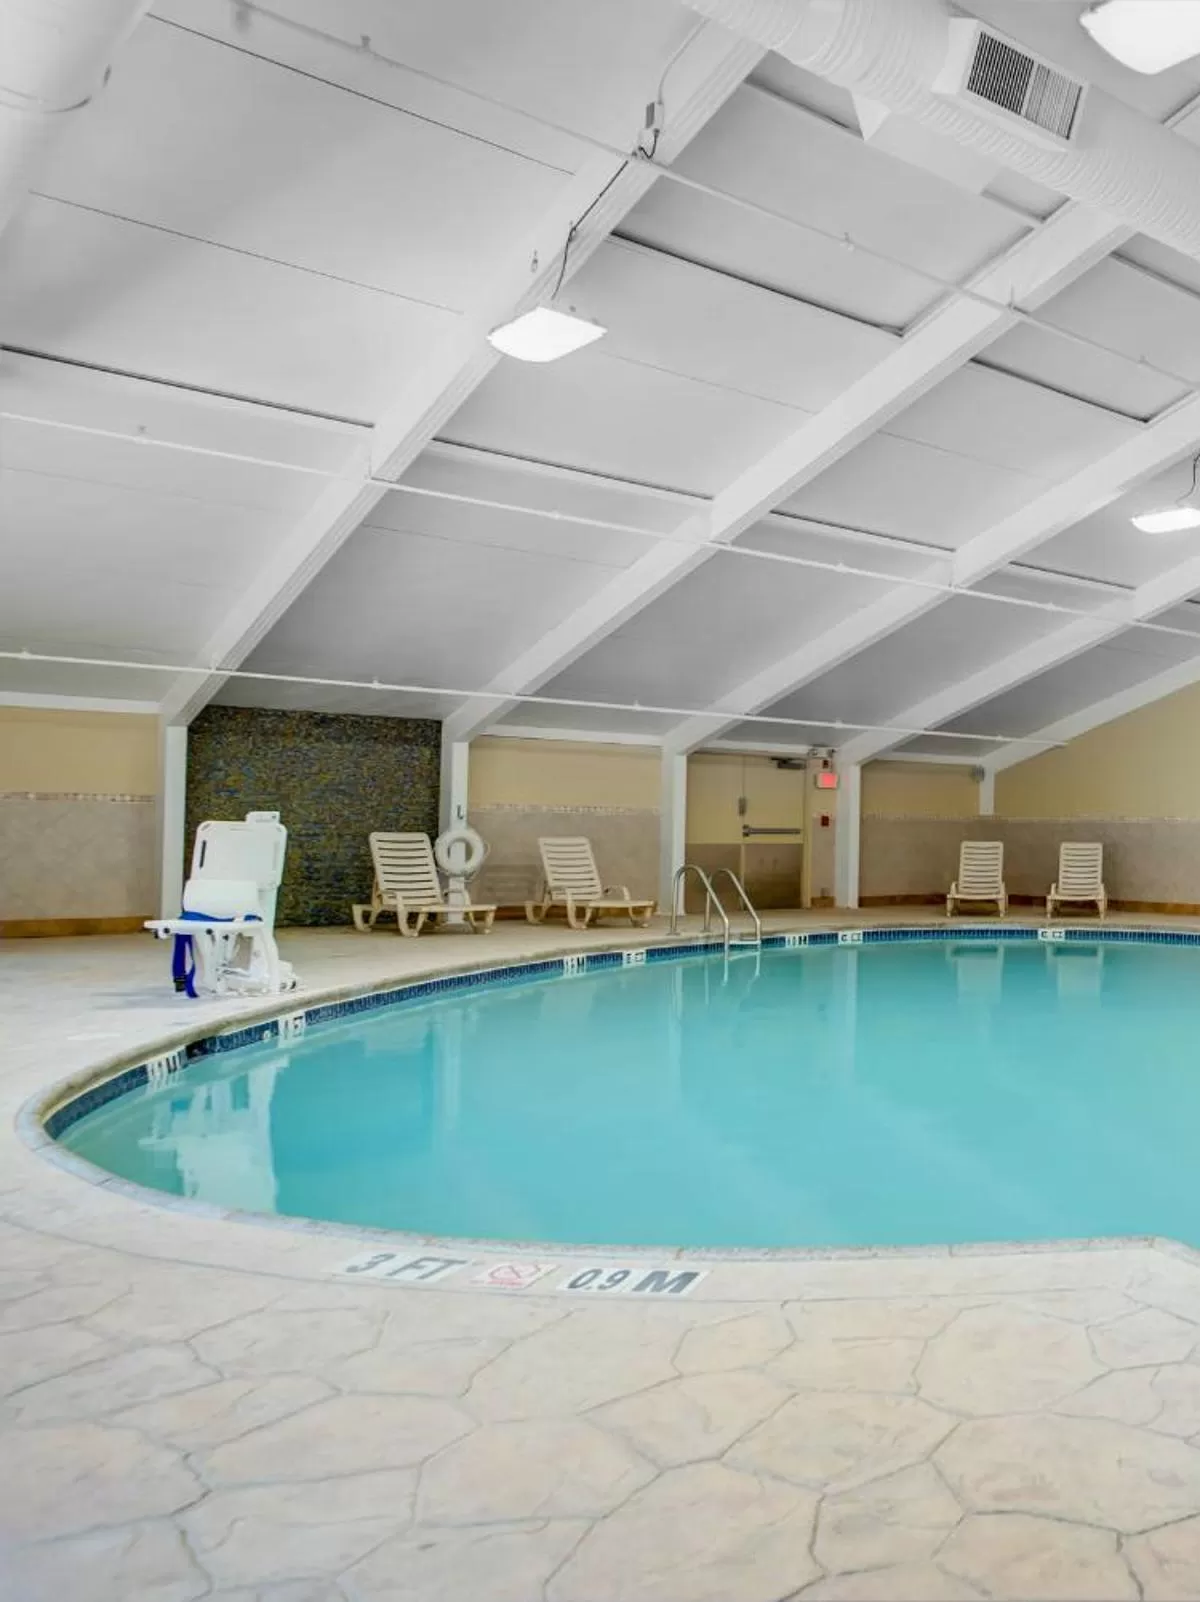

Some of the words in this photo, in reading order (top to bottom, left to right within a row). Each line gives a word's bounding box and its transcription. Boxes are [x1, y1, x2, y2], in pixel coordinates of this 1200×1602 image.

[345, 1253, 396, 1273] 3
[384, 1256, 468, 1280] FT
[567, 1268, 631, 1290] 0.9
[631, 1270, 700, 1294] M
